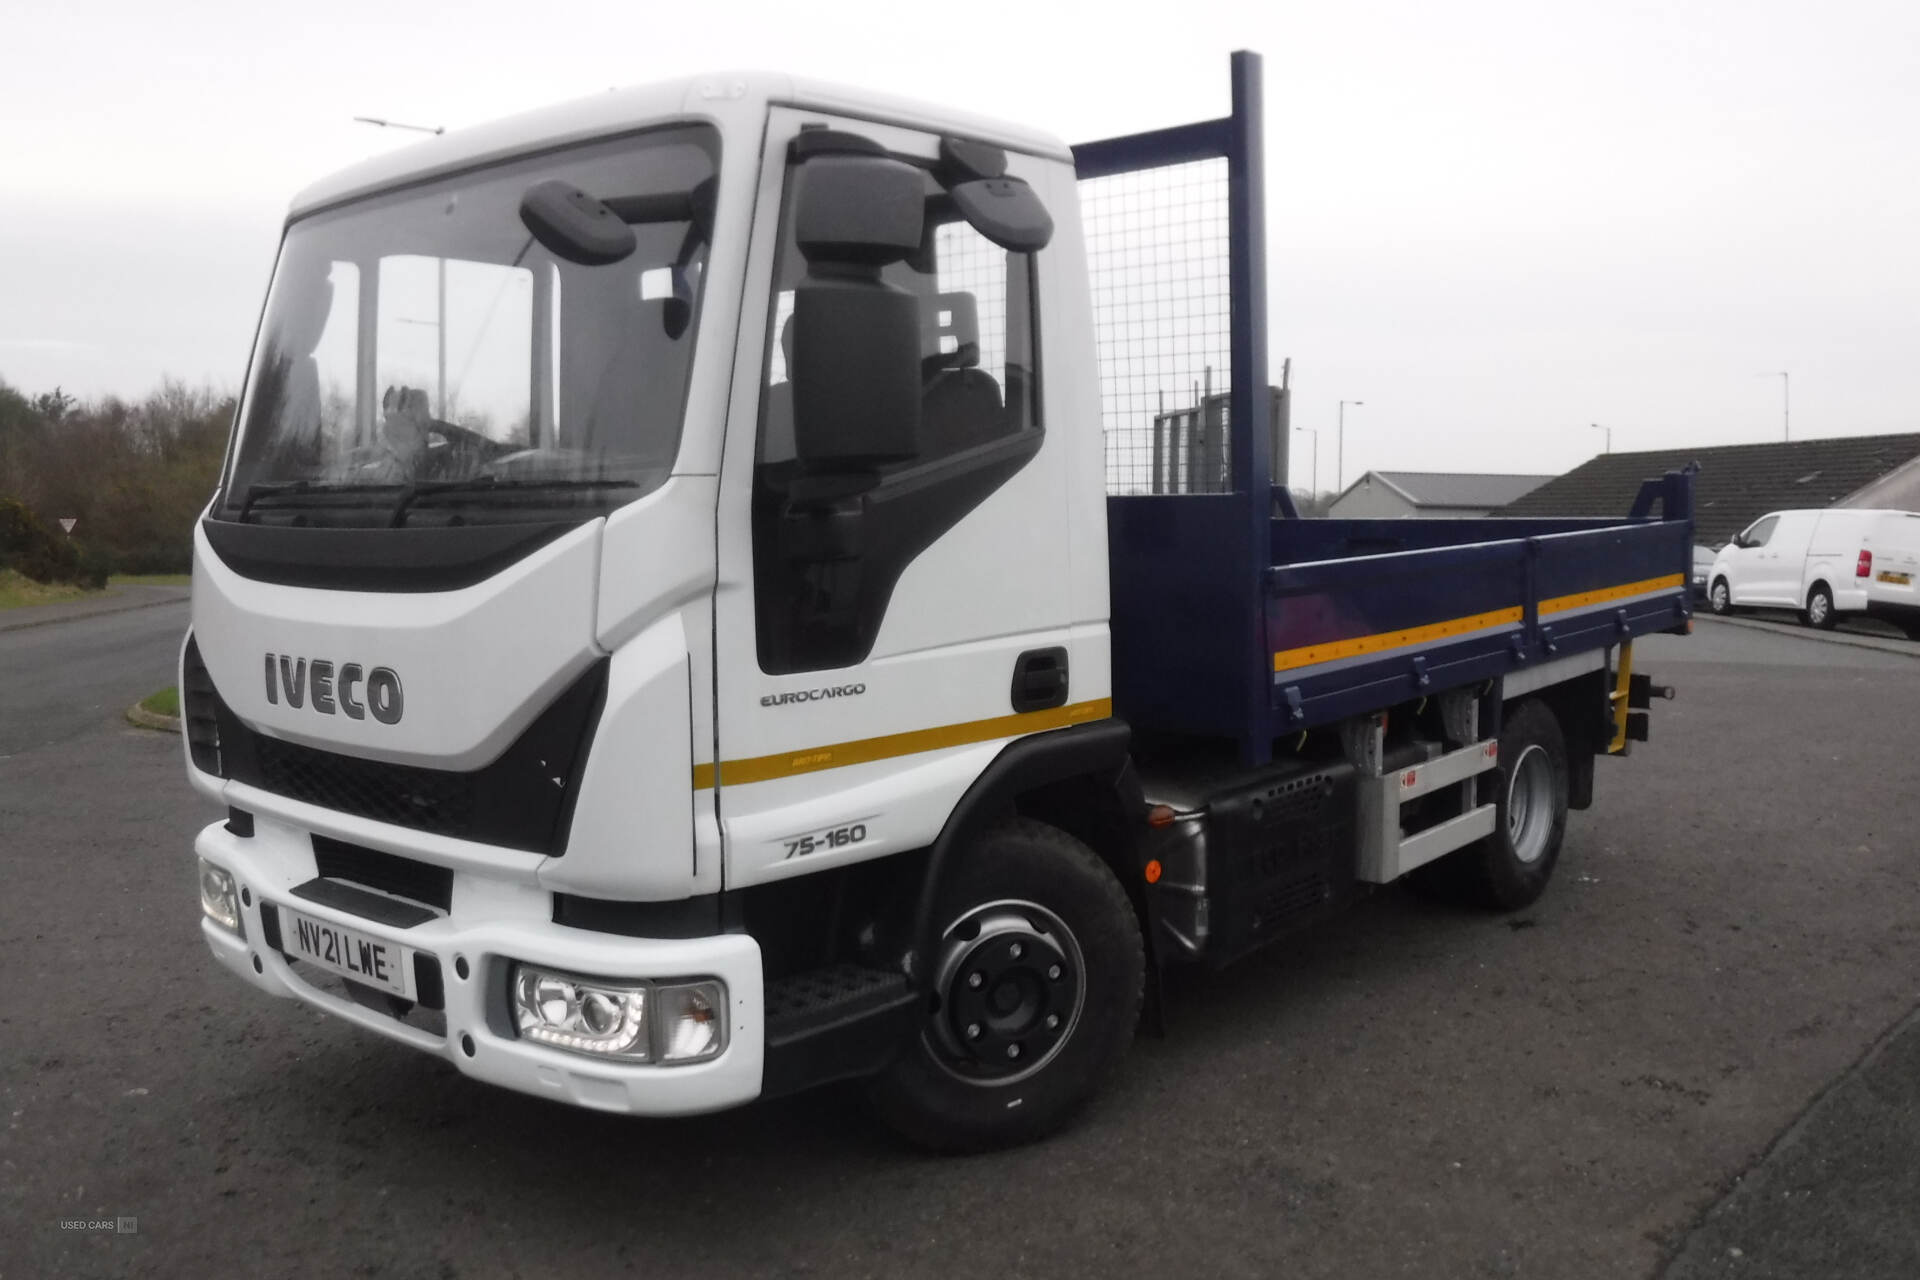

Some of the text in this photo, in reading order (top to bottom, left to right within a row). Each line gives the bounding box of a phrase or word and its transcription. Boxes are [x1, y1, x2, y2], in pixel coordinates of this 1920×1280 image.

[265, 653, 404, 725] IVECO
[760, 683, 866, 707] EUROCARGO
[784, 824, 867, 859] 75-160
[297, 918, 389, 982] NV21 LWE
